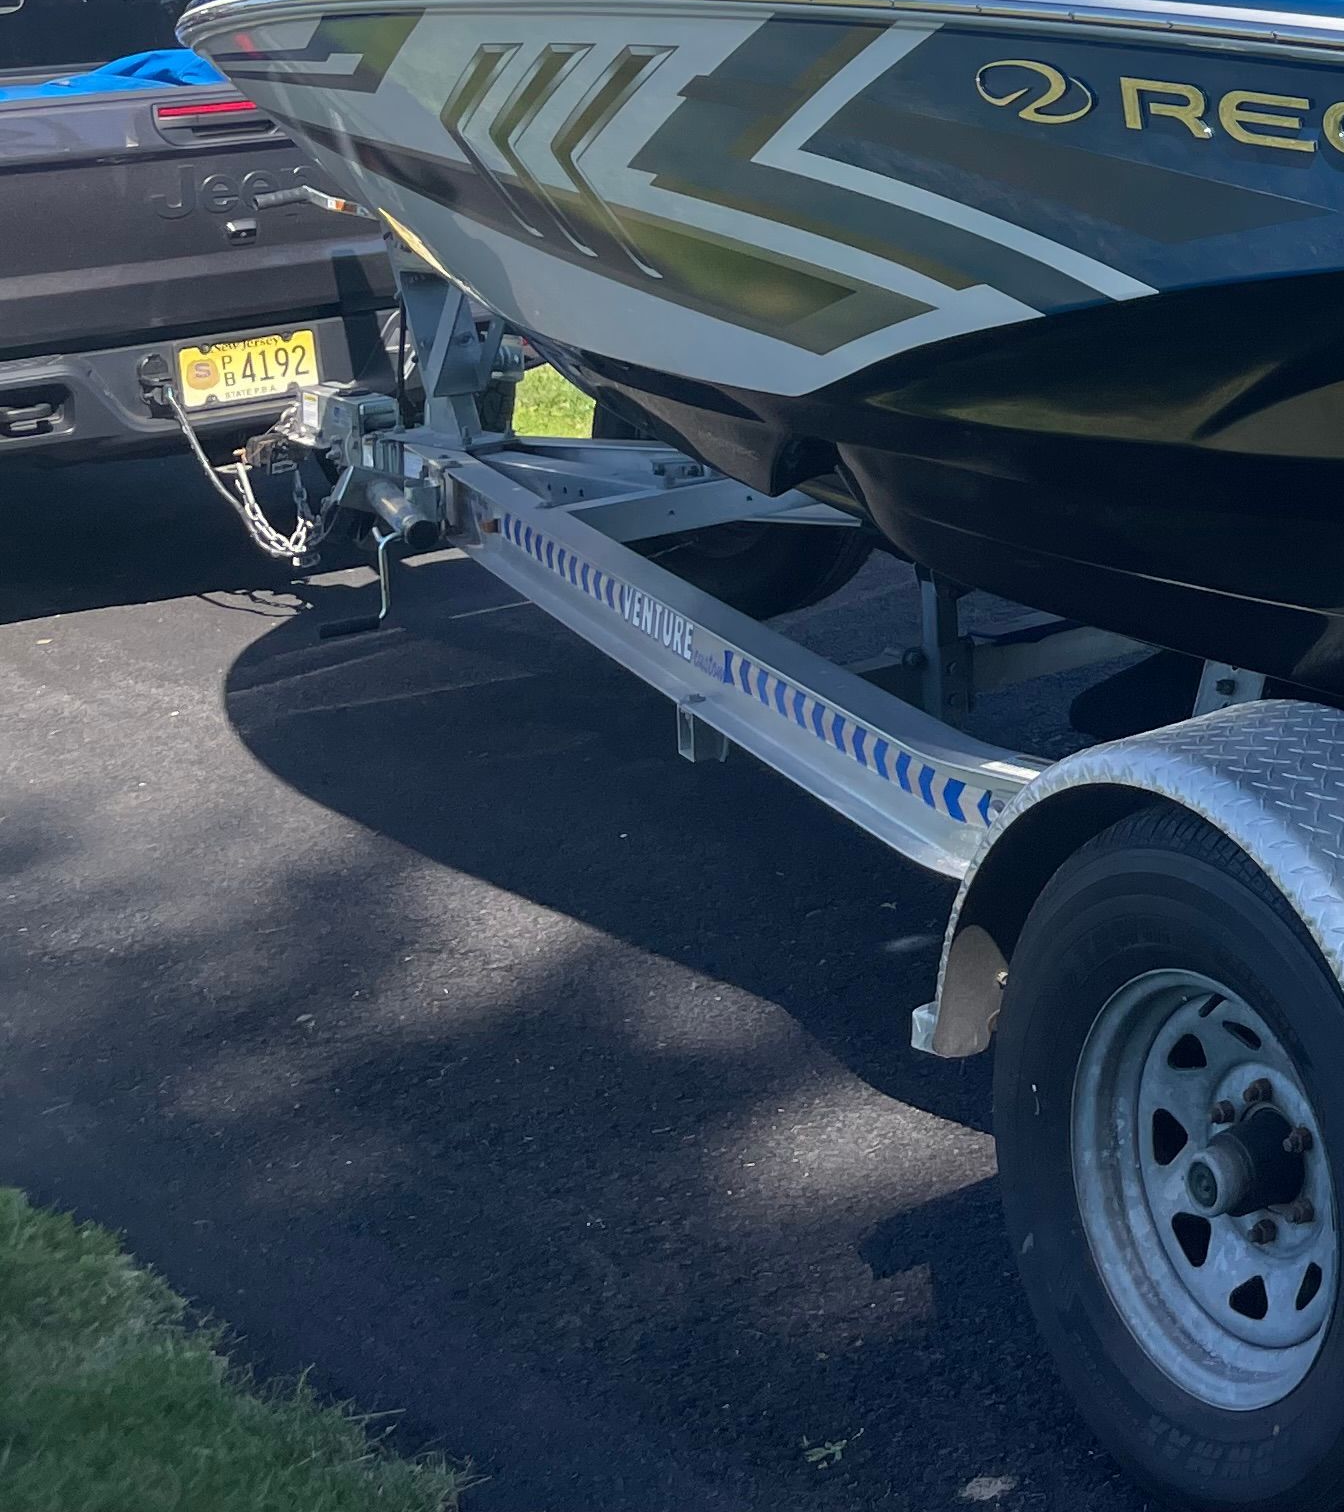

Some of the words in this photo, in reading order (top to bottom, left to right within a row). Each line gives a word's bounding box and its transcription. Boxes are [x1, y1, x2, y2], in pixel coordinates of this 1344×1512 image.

[241, 344, 310, 383] 4192
[224, 387, 251, 400] STATE
[624, 583, 694, 662] VENTURE
